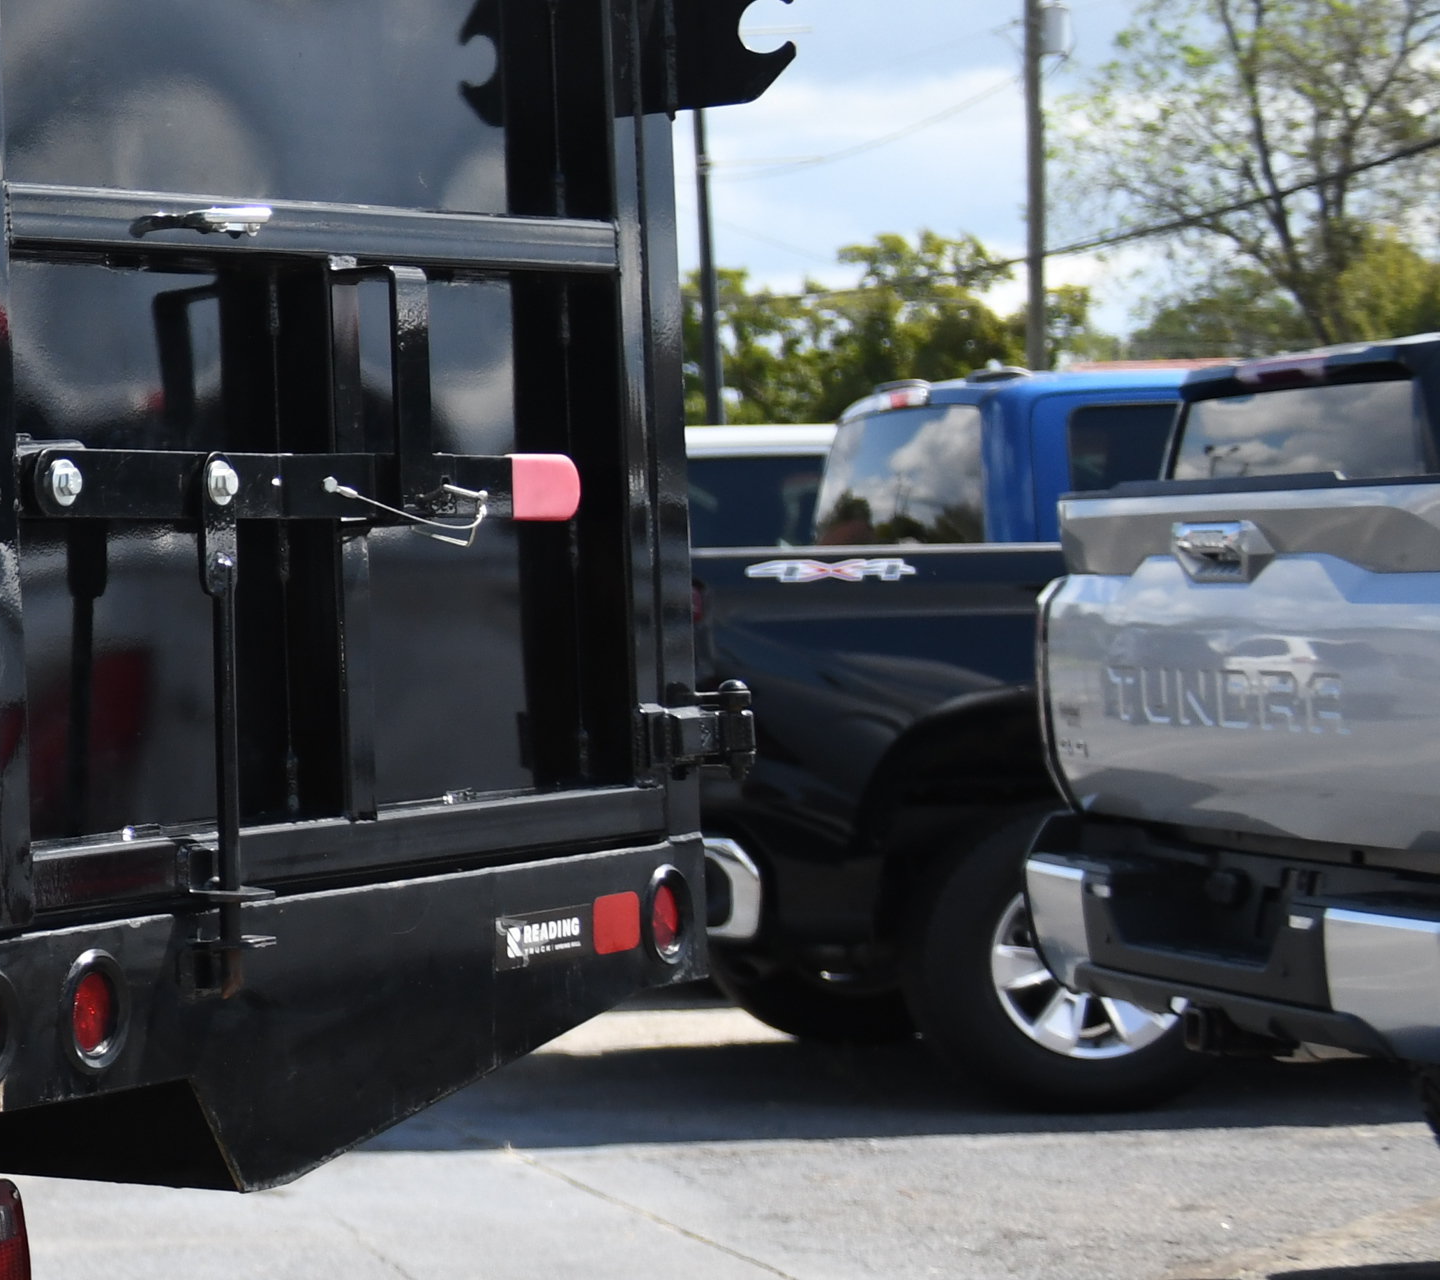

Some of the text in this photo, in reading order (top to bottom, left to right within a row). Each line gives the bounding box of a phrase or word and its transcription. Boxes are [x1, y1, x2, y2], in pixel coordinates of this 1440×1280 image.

[1104, 666, 1352, 736] TUNDRA
[523, 917, 580, 944] READING
[524, 944, 551, 955] TRUCK
